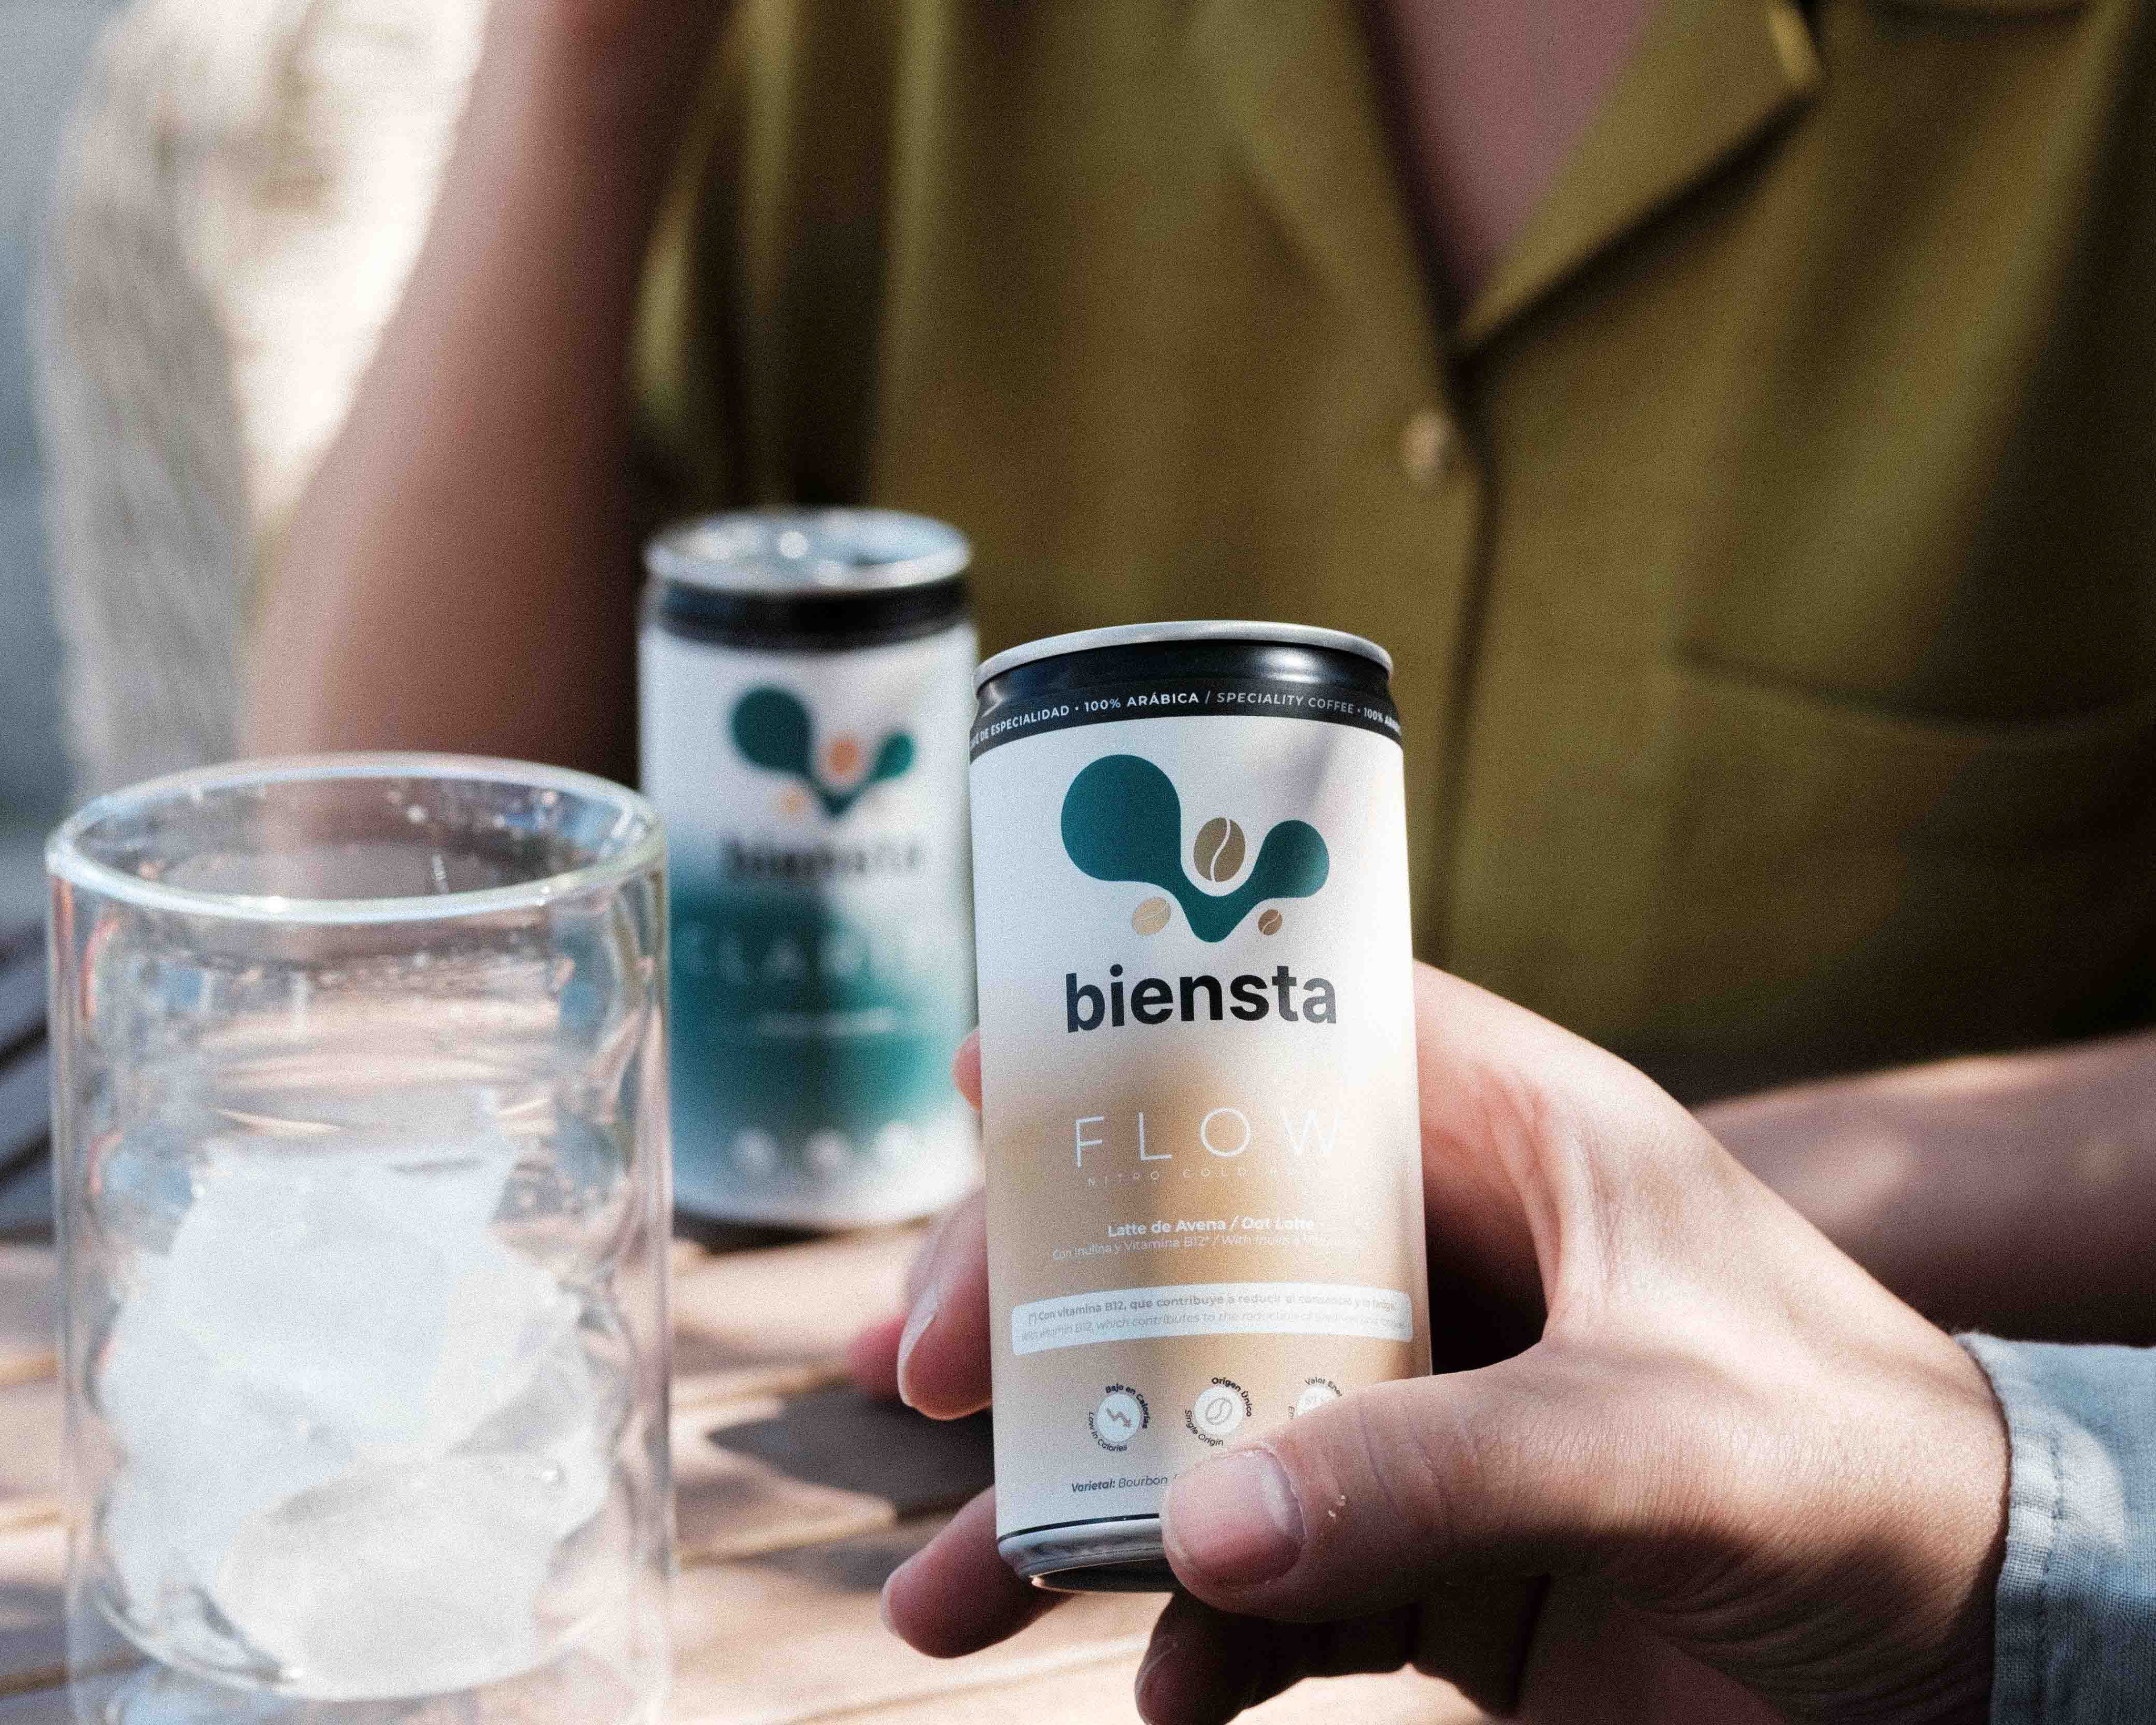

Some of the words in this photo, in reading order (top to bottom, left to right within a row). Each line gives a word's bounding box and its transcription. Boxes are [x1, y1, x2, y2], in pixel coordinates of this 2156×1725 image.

[980, 727, 990, 742] DE
[991, 705, 1070, 736] ESPECIALIDAD
[1084, 697, 1121, 712] 100%
[1126, 692, 1199, 707] ARÁBICA
[1216, 692, 1304, 706] SPECIALITY
[1308, 697, 1355, 714] COFFEE
[1065, 963, 1337, 1033] biensta
[1074, 1107, 1343, 1169] FLOW
[1107, 1222, 1146, 1238] Latte
[1151, 1220, 1172, 1234] de
[1175, 1218, 1227, 1232] Avena
[1038, 1308, 1056, 1322] Con
[1057, 1303, 1102, 1318] vitamina
[1130, 1300, 1153, 1311] que
[1156, 1294, 1224, 1308] contribuye
[1096, 1318, 1130, 1330] which
[1132, 1313, 1201, 1328] contributes
[1105, 1383, 1124, 1394] Bajo
[1125, 1386, 1136, 1395] en
[1211, 1377, 1242, 1392] Origen
[1304, 1376, 1326, 1385] Valor
[1184, 1408, 1198, 1435] Single
[1198, 1433, 1225, 1447] Origin
[1091, 1430, 1099, 1439] in
[1097, 1438, 1128, 1452] Calories
[1071, 1478, 1116, 1493] Varietal:
[1118, 1475, 1169, 1488] Bourbon
